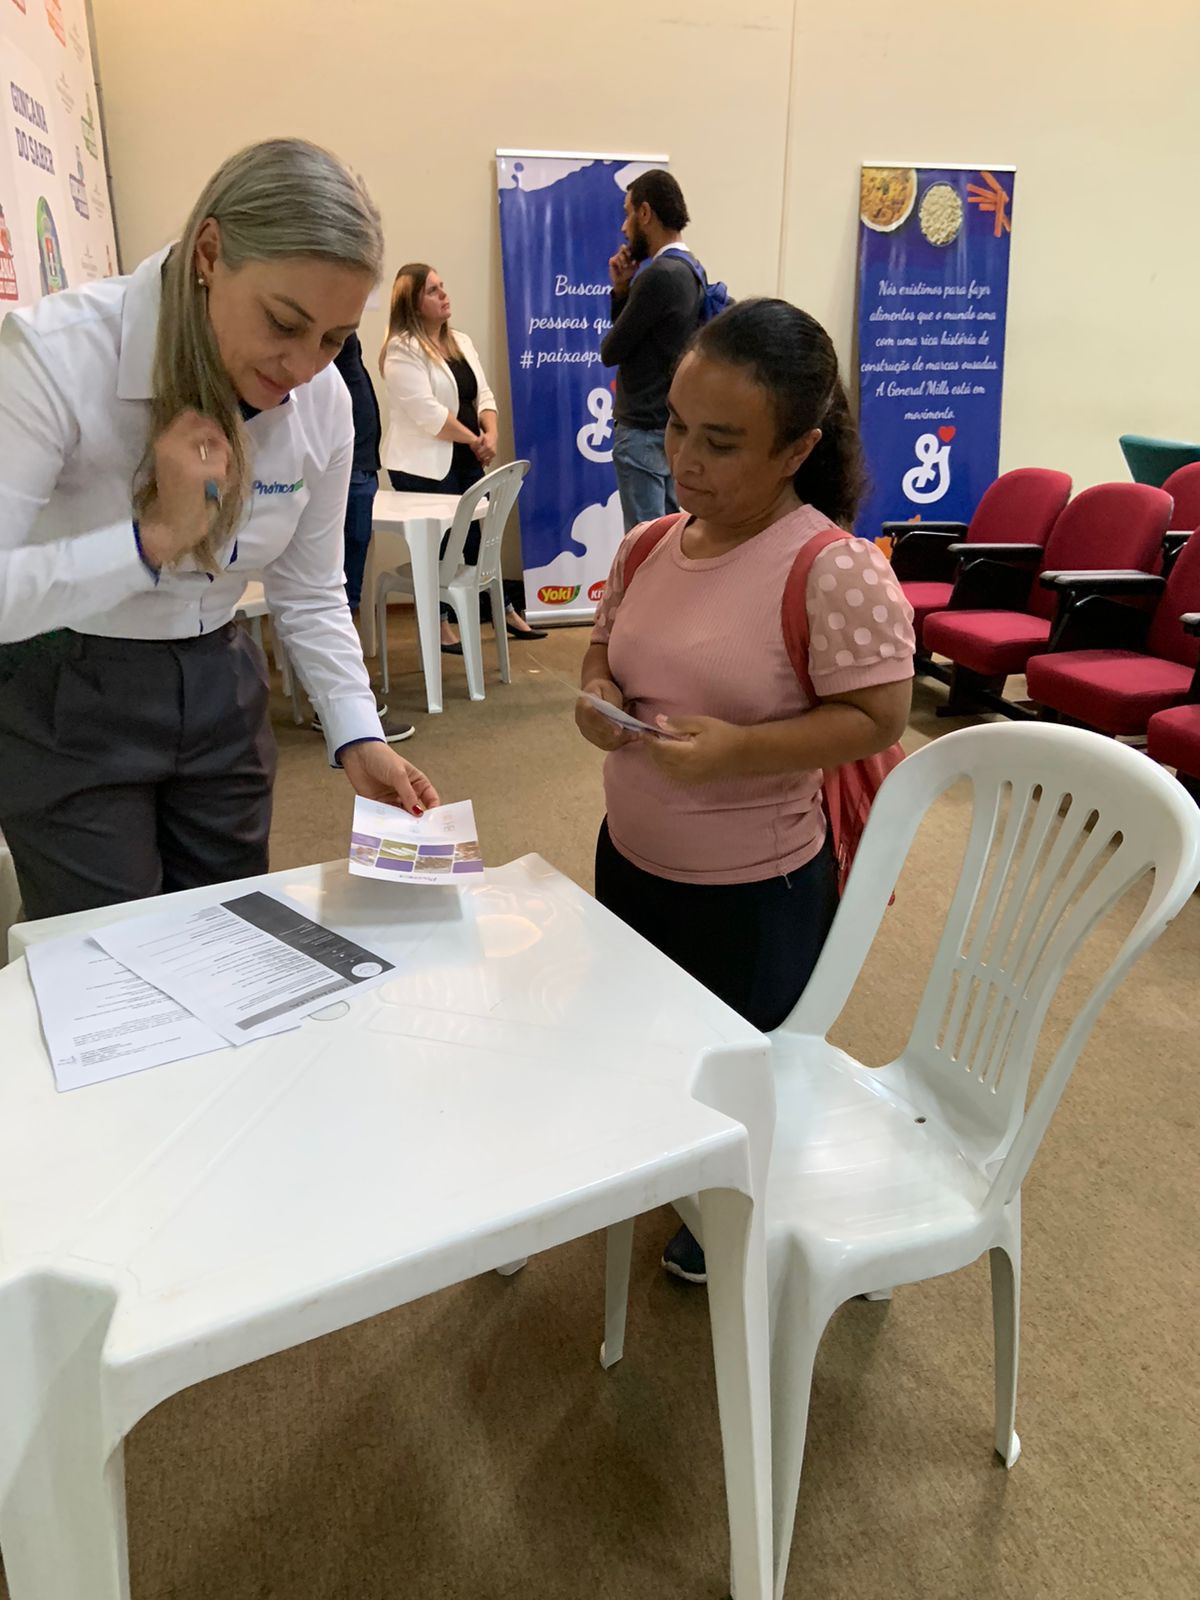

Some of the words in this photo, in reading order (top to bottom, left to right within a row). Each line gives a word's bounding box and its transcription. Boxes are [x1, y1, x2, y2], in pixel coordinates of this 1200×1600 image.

[15, 126, 30, 162] DO
[28, 135, 56, 176] SABER
[899, 282, 942, 296] existimos
[943, 285, 967, 299] para
[967, 280, 991, 299] fazer
[869, 306, 915, 321] alimentos
[917, 311, 934, 325] que
[935, 311, 942, 321] o
[943, 305, 977, 321] mundo
[976, 311, 996, 321] ama
[528, 316, 589, 335] pessoas
[593, 318, 613, 335] qu
[875, 336, 895, 347] com
[897, 337, 918, 347] uma
[921, 334, 938, 346] rica
[940, 330, 977, 346] história
[977, 330, 990, 346] de
[860, 358, 910, 374] construção
[911, 356, 924, 371] de
[925, 360, 959, 371] marcas
[887, 381, 926, 397] General
[925, 380, 950, 397] Mills
[951, 383, 971, 395] está
[972, 386, 986, 395] em
[541, 588, 572, 602] Yoki
